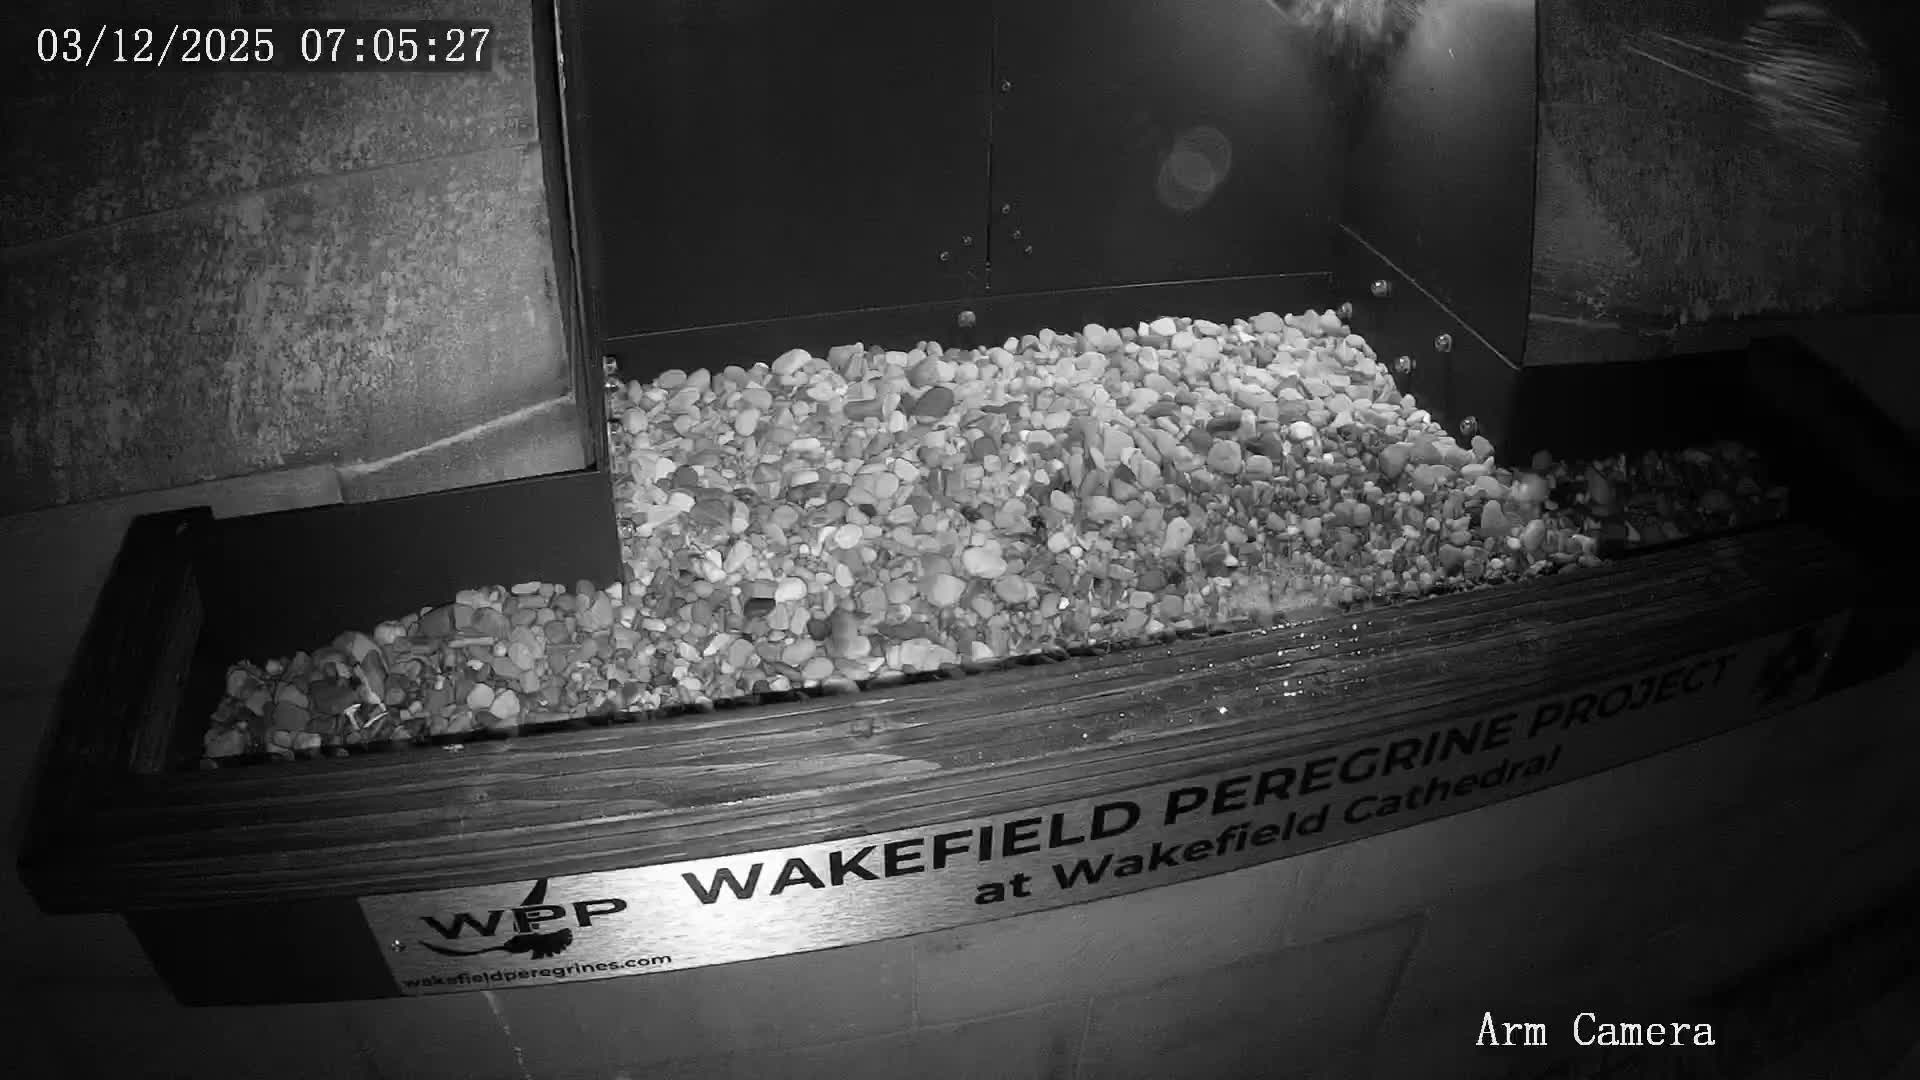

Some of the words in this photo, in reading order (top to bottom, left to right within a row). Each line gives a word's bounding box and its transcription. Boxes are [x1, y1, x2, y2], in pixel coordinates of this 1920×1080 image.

[682, 801, 1141, 905] WAKEFIELD
[1164, 713, 1518, 826] PEREGRINE
[1528, 654, 1737, 738] PROJECT
[974, 872, 1032, 905] at
[1052, 806, 1327, 890] Wakefield
[1343, 745, 1563, 825] Cathedral
[418, 898, 628, 940] WPP
[402, 953, 672, 989] wakefieldperegrines.com
